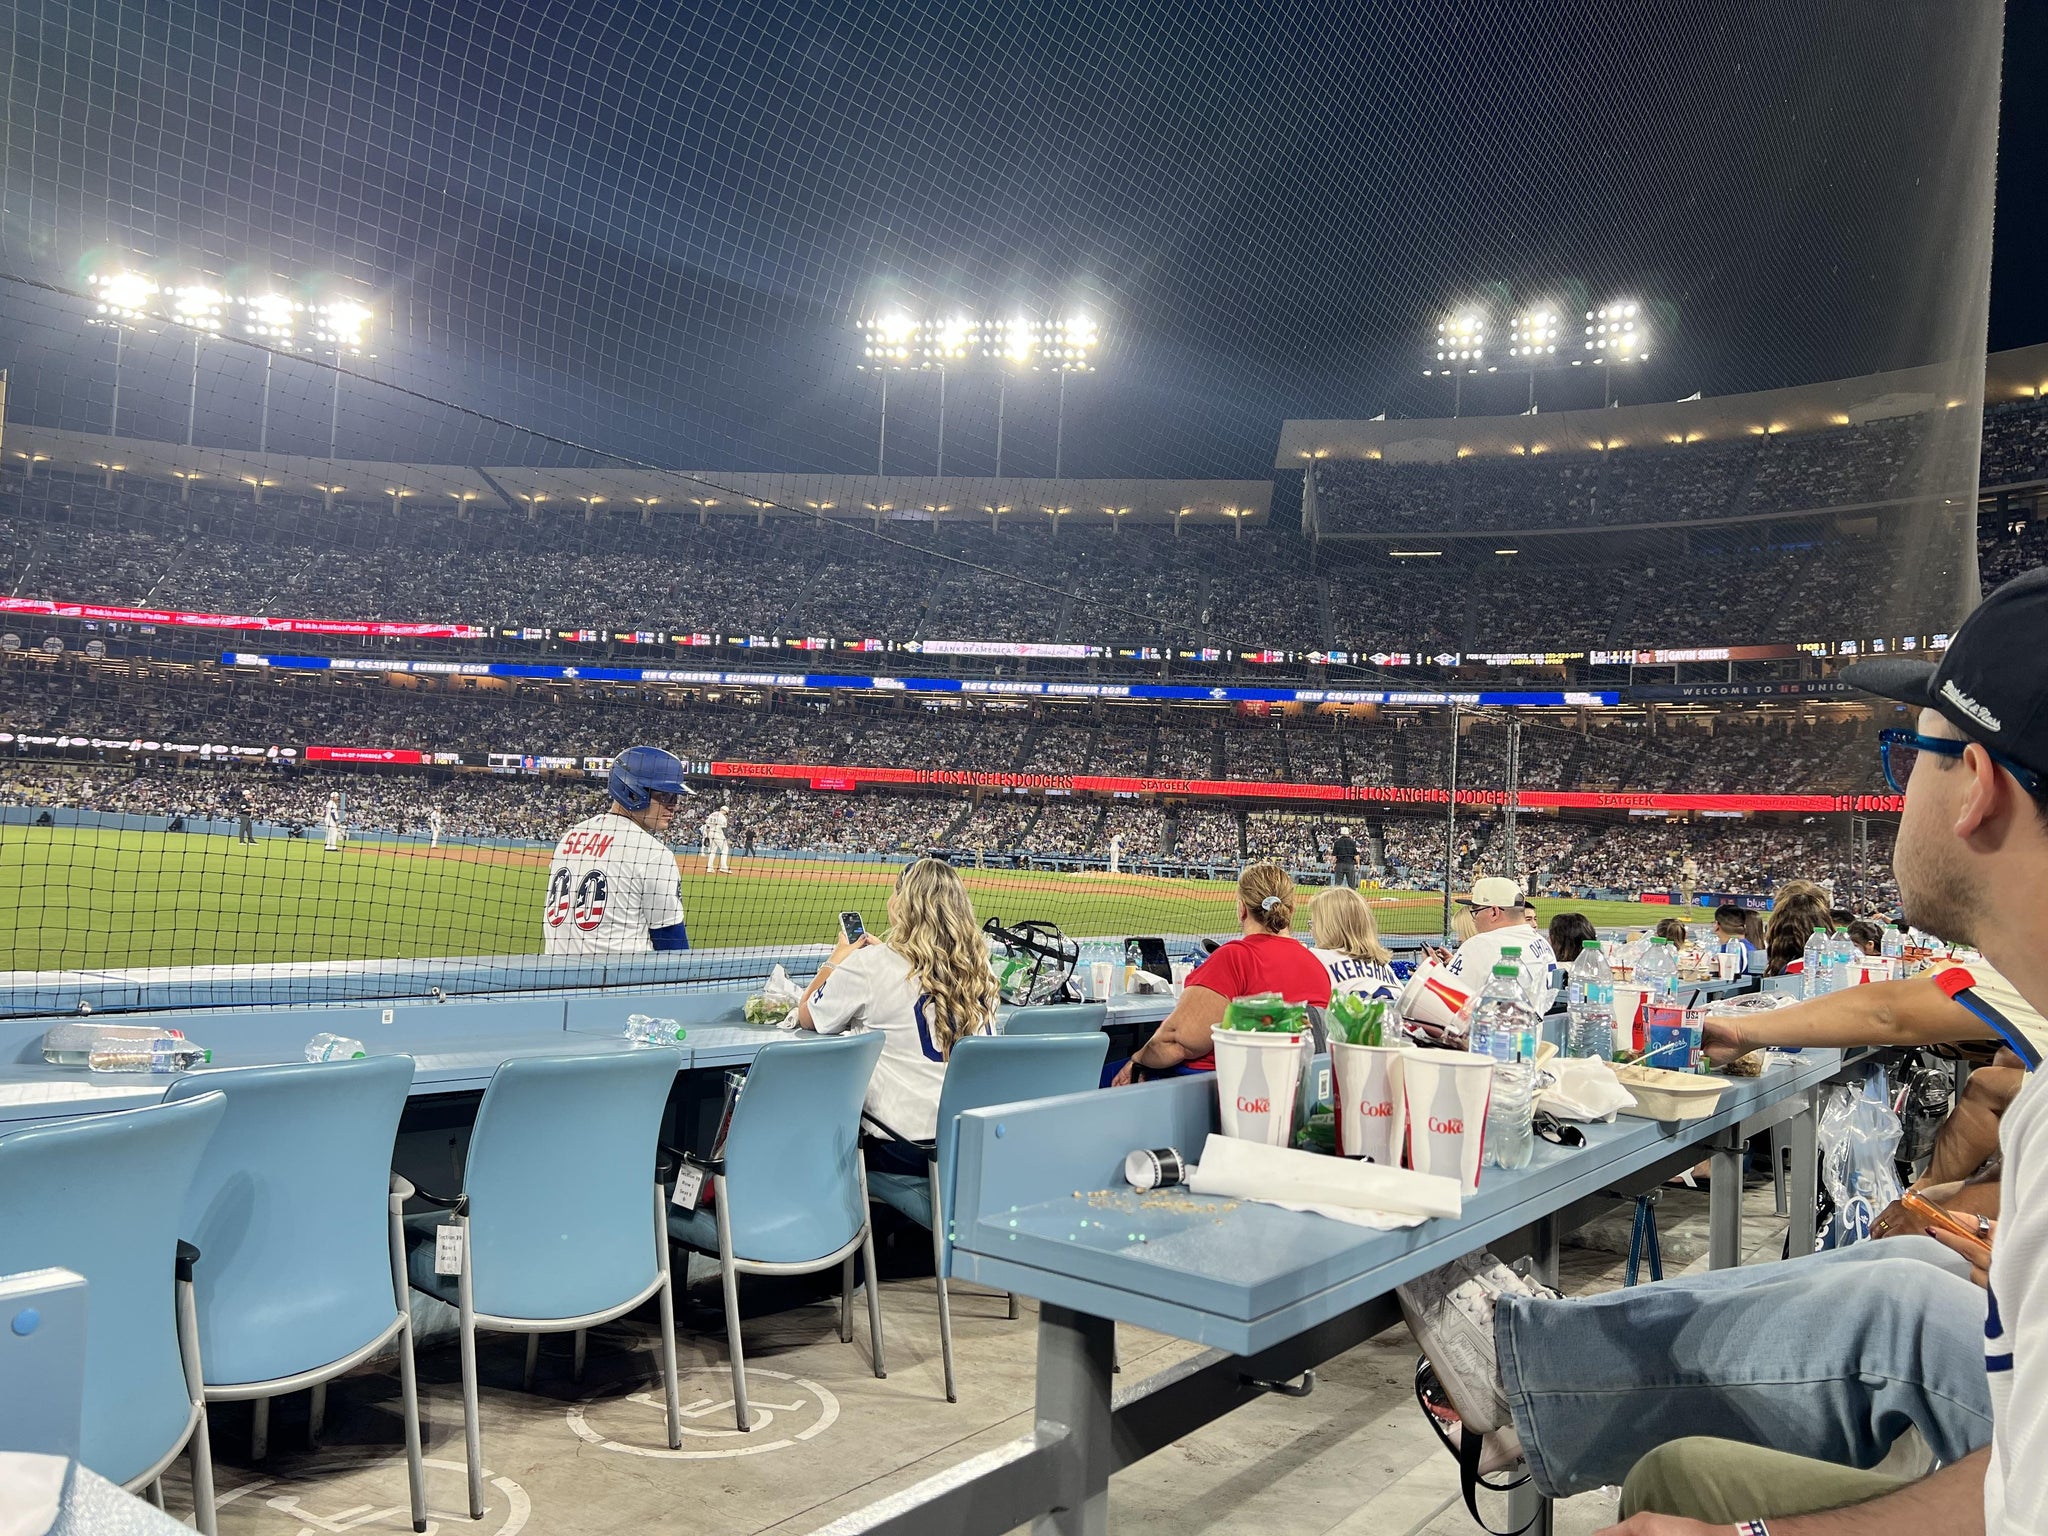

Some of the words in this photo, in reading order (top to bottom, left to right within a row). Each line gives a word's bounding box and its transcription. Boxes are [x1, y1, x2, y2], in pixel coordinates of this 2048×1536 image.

[1802, 643, 1820, 651] FOR
[1902, 642, 1916, 651] 39
[1668, 650, 1697, 661] GAVIN
[1697, 649, 1729, 660] SHEETS
[330, 659, 356, 668] NEW
[357, 660, 409, 670] COASTER
[412, 663, 461, 673] SUMMER
[641, 671, 668, 680] NEW
[669, 672, 721, 681] COASTER
[725, 674, 775, 683] SUMMER
[961, 682, 987, 690] NEW
[989, 682, 1042, 692] COASTER
[1047, 685, 1099, 694] SUMMER
[1683, 687, 1749, 696] WELCOME
[1756, 686, 1772, 694] TO
[1295, 692, 1322, 700] NEW
[1327, 692, 1384, 701] COASTER
[1389, 693, 1445, 702] SUMMER
[727, 764, 774, 776] SEATGEEK
[914, 769, 936, 784] THE
[937, 770, 959, 784] LOS
[961, 771, 1014, 786] ANGELES
[1016, 773, 1074, 788] DODGERS
[1140, 780, 1191, 792] SEATGEEK
[1343, 786, 1367, 800] THE
[1368, 787, 1392, 801] LOS
[1395, 788, 1451, 803] ANGELES
[1598, 795, 1655, 806] SEATGEEK
[1861, 796, 1890, 812] LOS
[562, 831, 615, 859] SEAN
[546, 866, 609, 932] 00
[1679, 895, 1700, 904] be
[1746, 897, 1766, 908] blue
[1652, 1037, 1688, 1056] Dgers
[1236, 1096, 1270, 1113] Coke
[1360, 1099, 1394, 1117] Coke
[1428, 1116, 1464, 1135] Coke
